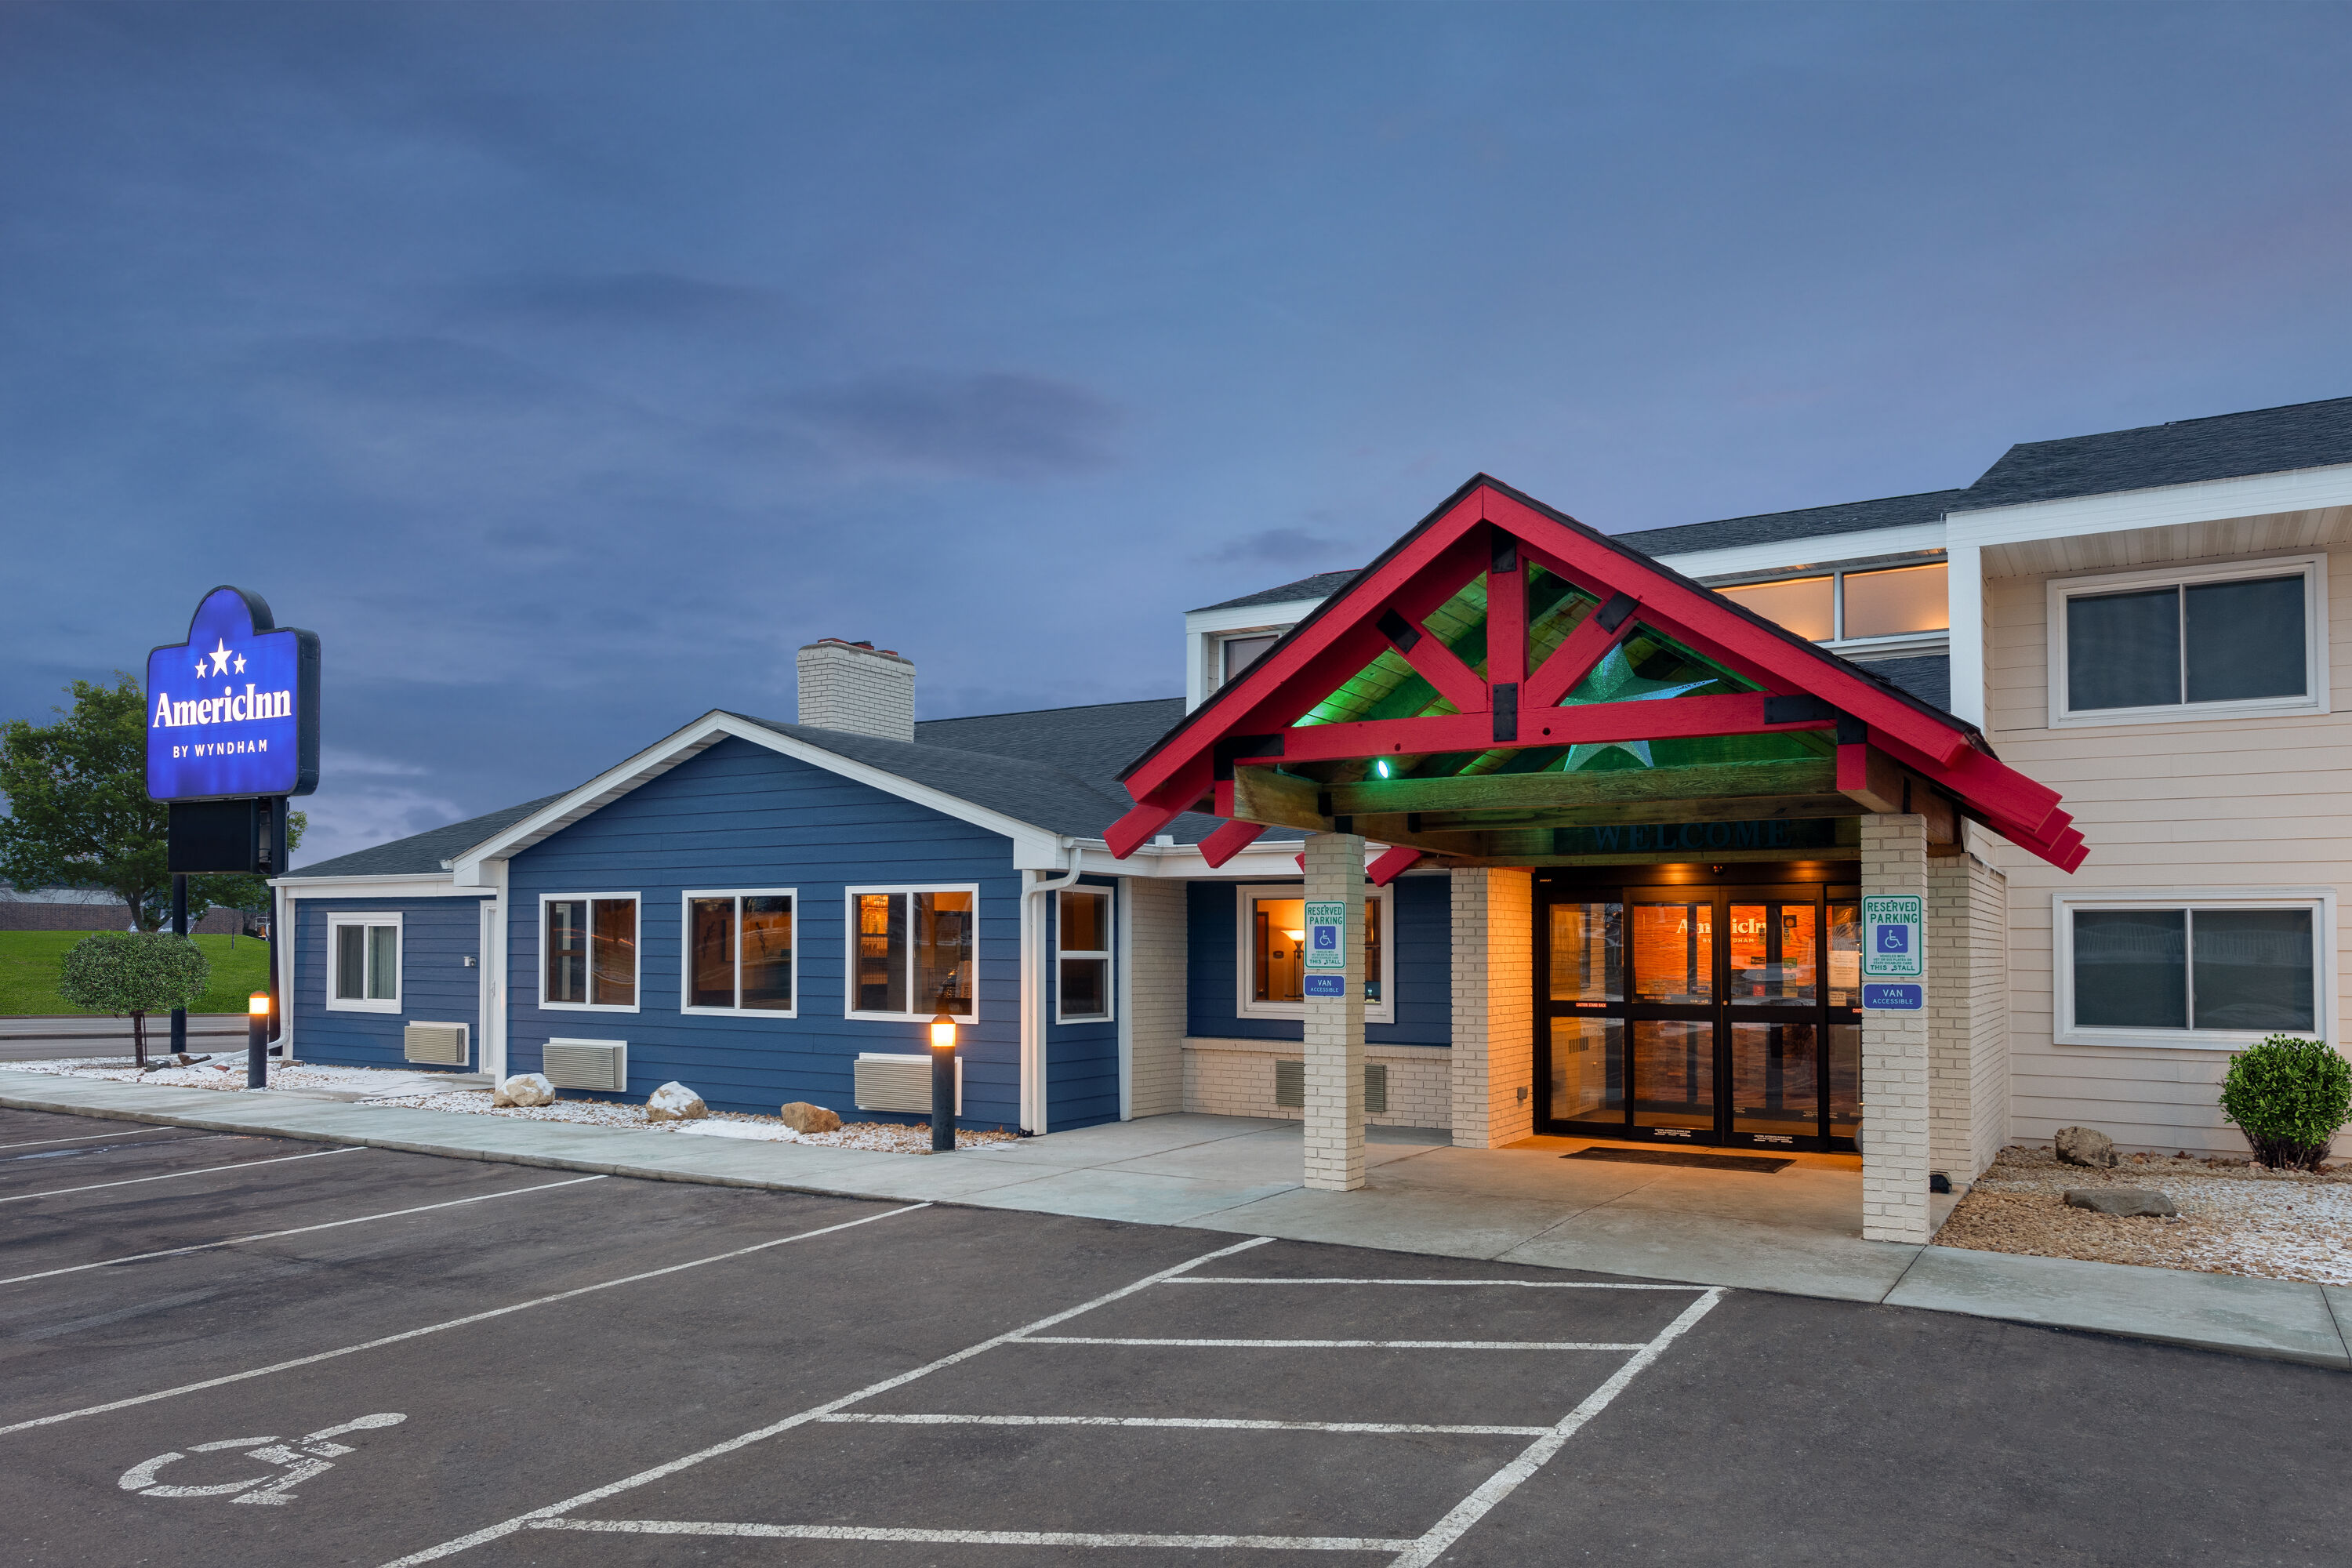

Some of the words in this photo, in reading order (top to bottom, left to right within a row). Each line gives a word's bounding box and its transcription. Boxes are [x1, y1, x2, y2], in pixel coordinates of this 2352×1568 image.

[152, 684, 292, 728] AmericInn
[172, 746, 189, 758] BY
[194, 739, 267, 757] WYNDHAM
[1593, 819, 1793, 851] WELCOME
[1308, 906, 1342, 916] RESERVED
[1867, 902, 1917, 912] RESERVED
[1309, 916, 1343, 925] PARKING
[1870, 913, 1918, 924] PARKING
